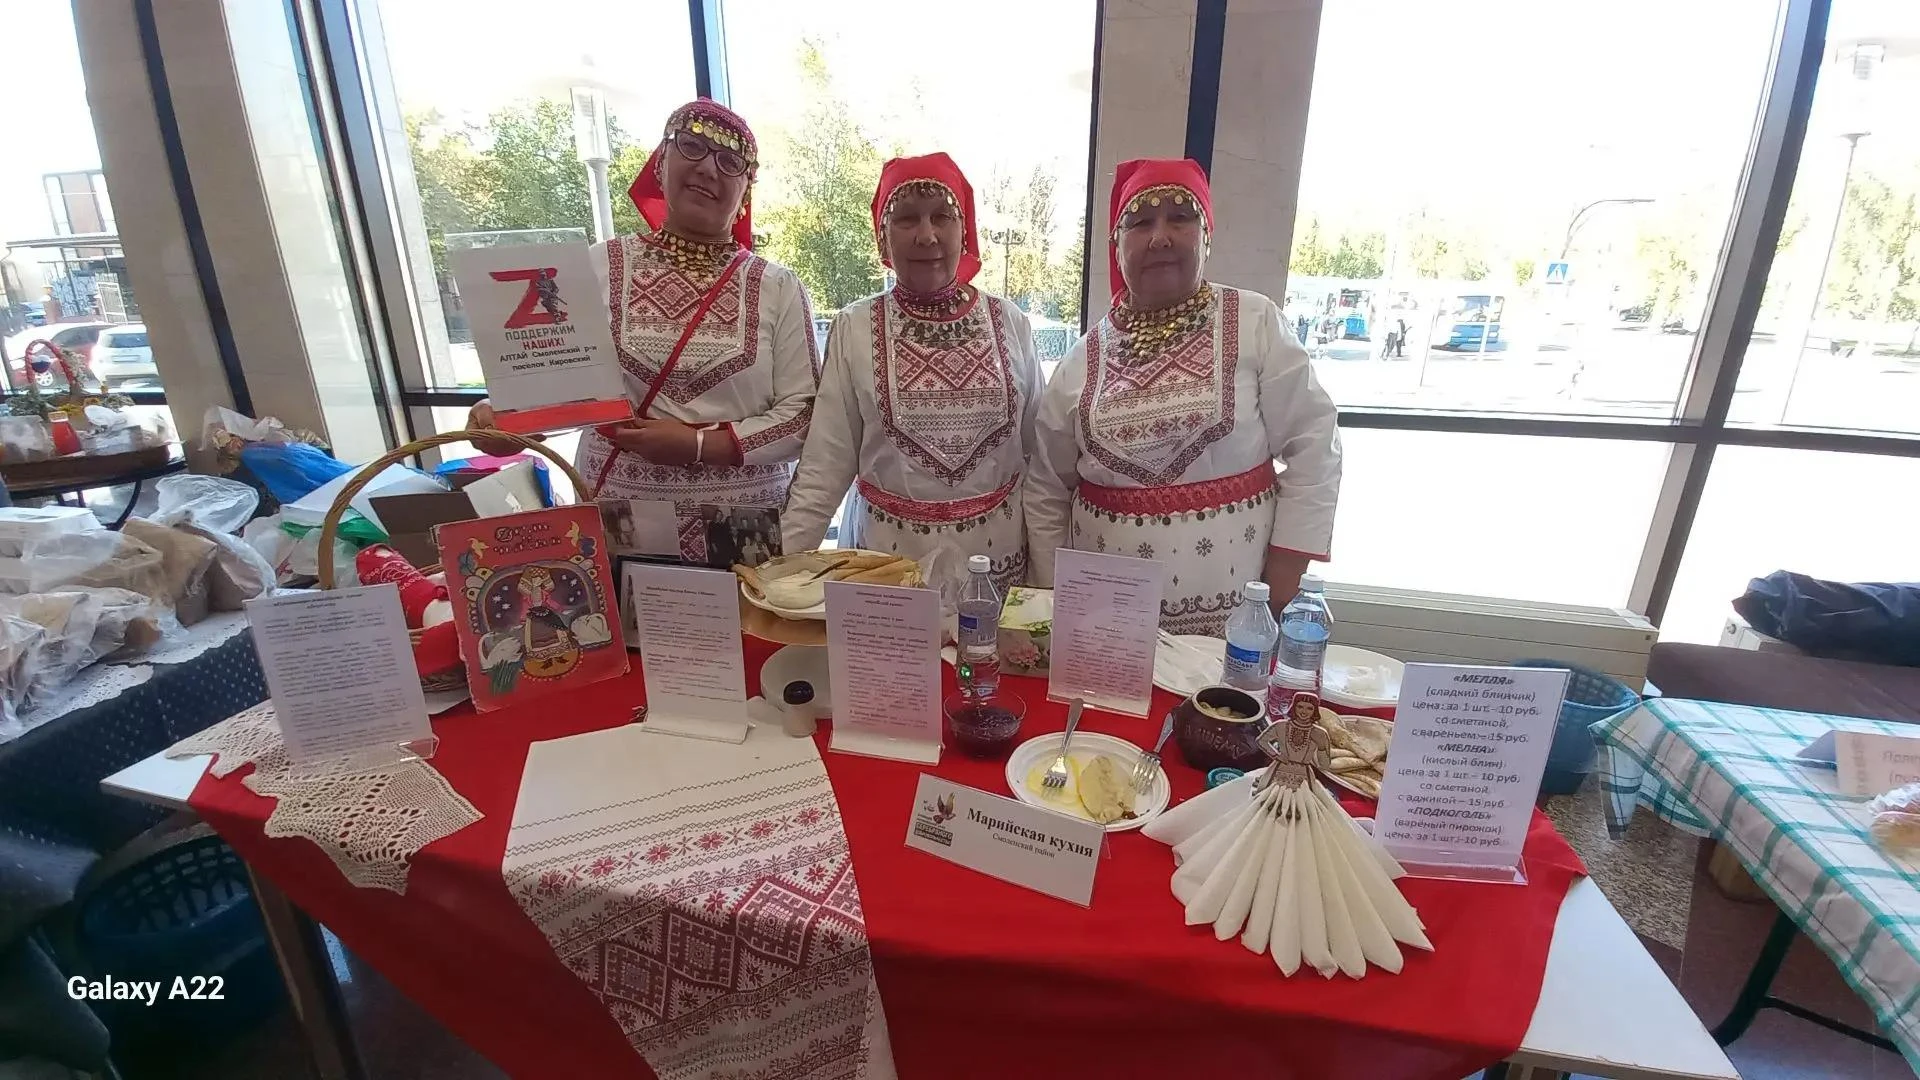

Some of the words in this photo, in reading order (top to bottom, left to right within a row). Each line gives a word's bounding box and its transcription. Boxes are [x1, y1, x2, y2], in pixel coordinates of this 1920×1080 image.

[505, 324, 576, 342] ПОДДЕРЖИМ
[522, 337, 565, 351] НАШИХ!
[500, 349, 529, 363] АЛТАЙ
[532, 345, 580, 359] Смоленский
[549, 355, 591, 369] Кировский
[1426, 686, 1479, 698] (сладкий
[1481, 689, 1536, 703] блинчик)
[1446, 703, 1458, 711] за
[1498, 705, 1513, 715] 10
[1435, 716, 1448, 725] со
[1412, 729, 1418, 737] с
[1489, 733, 1504, 741] 15
[1422, 755, 1467, 766] (кислый
[1427, 769, 1440, 778] за
[1481, 773, 1494, 781] 10
[1406, 795, 1457, 805] аджикой
[1468, 798, 1481, 806] 15
[967, 807, 1046, 844] Марийская
[1049, 835, 1094, 858] кухня
[1448, 822, 1502, 835] пирожок)
[1416, 833, 1428, 841] за
[992, 832, 1034, 852] Смоленский
[1034, 846, 1056, 860] район
